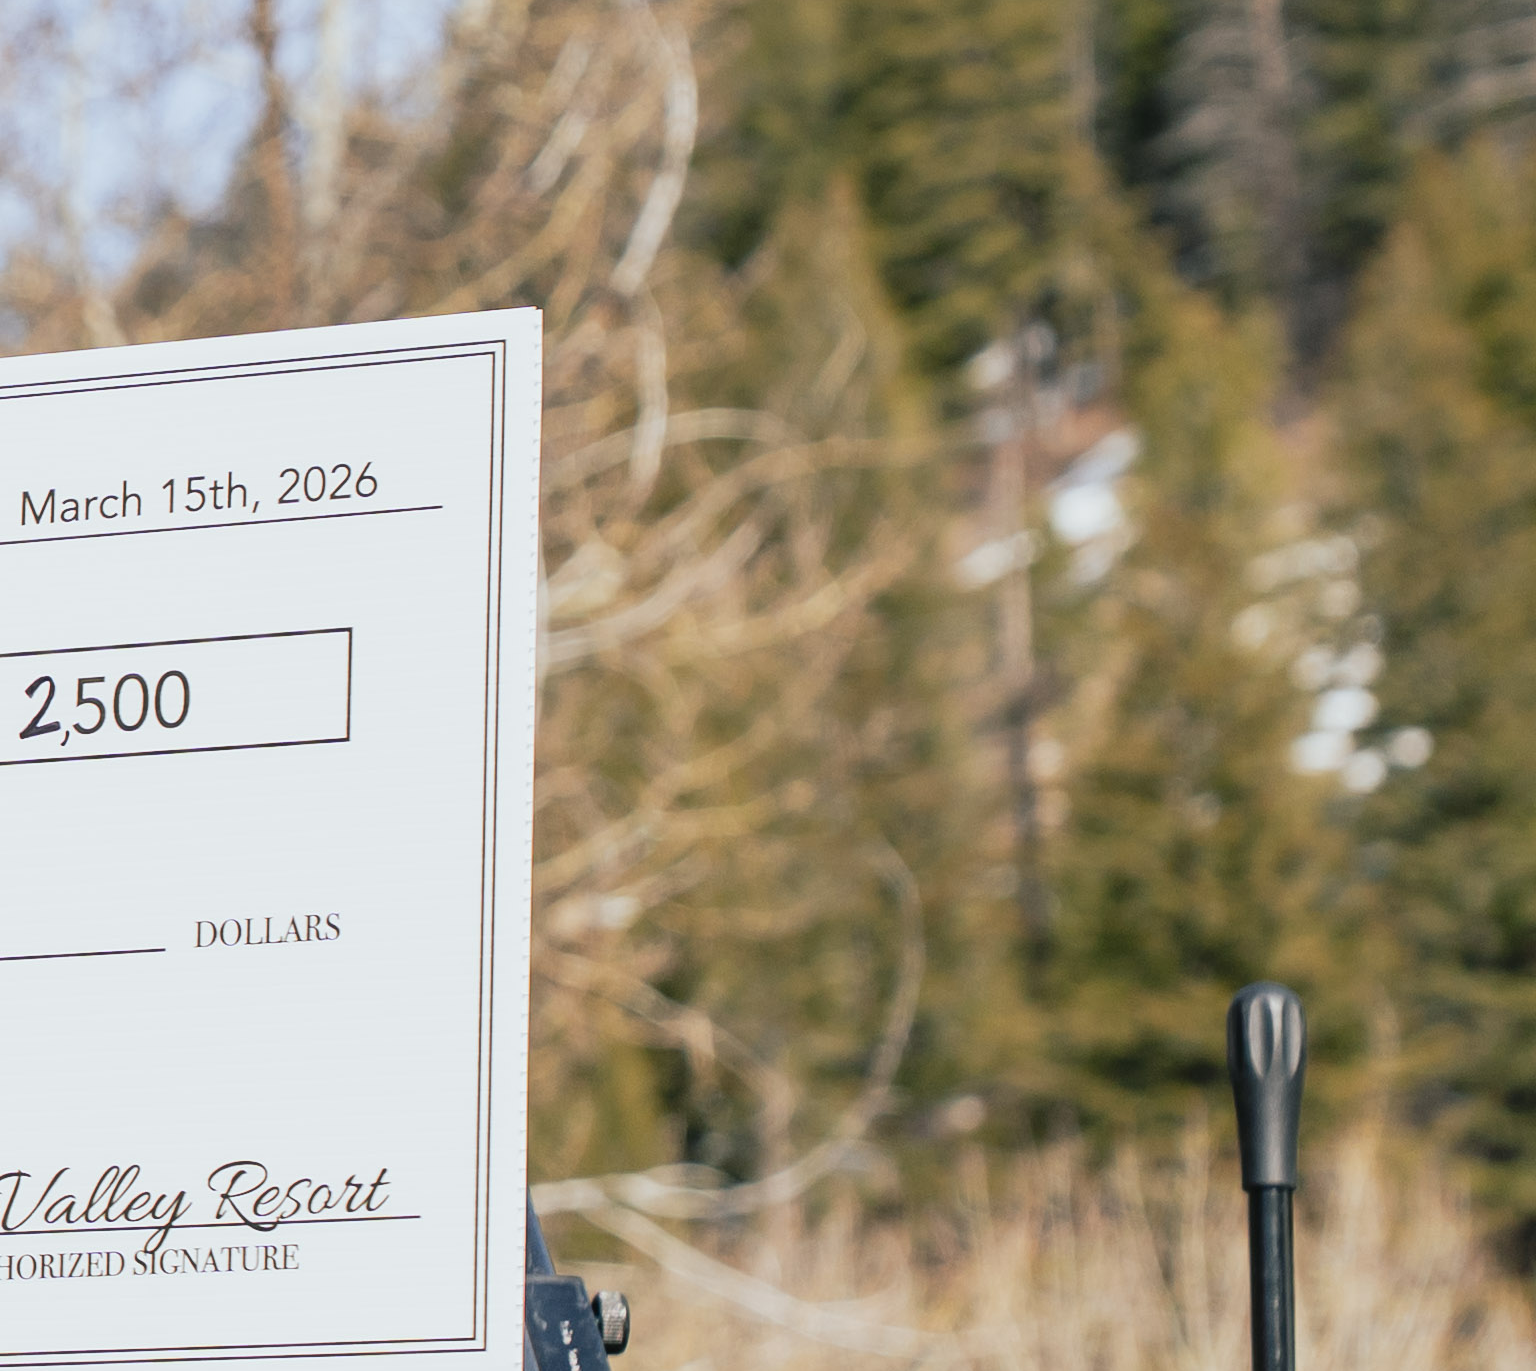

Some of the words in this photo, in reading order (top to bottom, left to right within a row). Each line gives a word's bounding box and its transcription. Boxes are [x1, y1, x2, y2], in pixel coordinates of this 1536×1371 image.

[21, 480, 142, 526] March
[162, 471, 260, 514] 15th,
[277, 461, 378, 505] 2026
[19, 670, 190, 747] 2,500
[194, 912, 341, 948] DOLLARS
[208, 1160, 391, 1232] Resort
[132, 1243, 300, 1277] SIGNATURE
